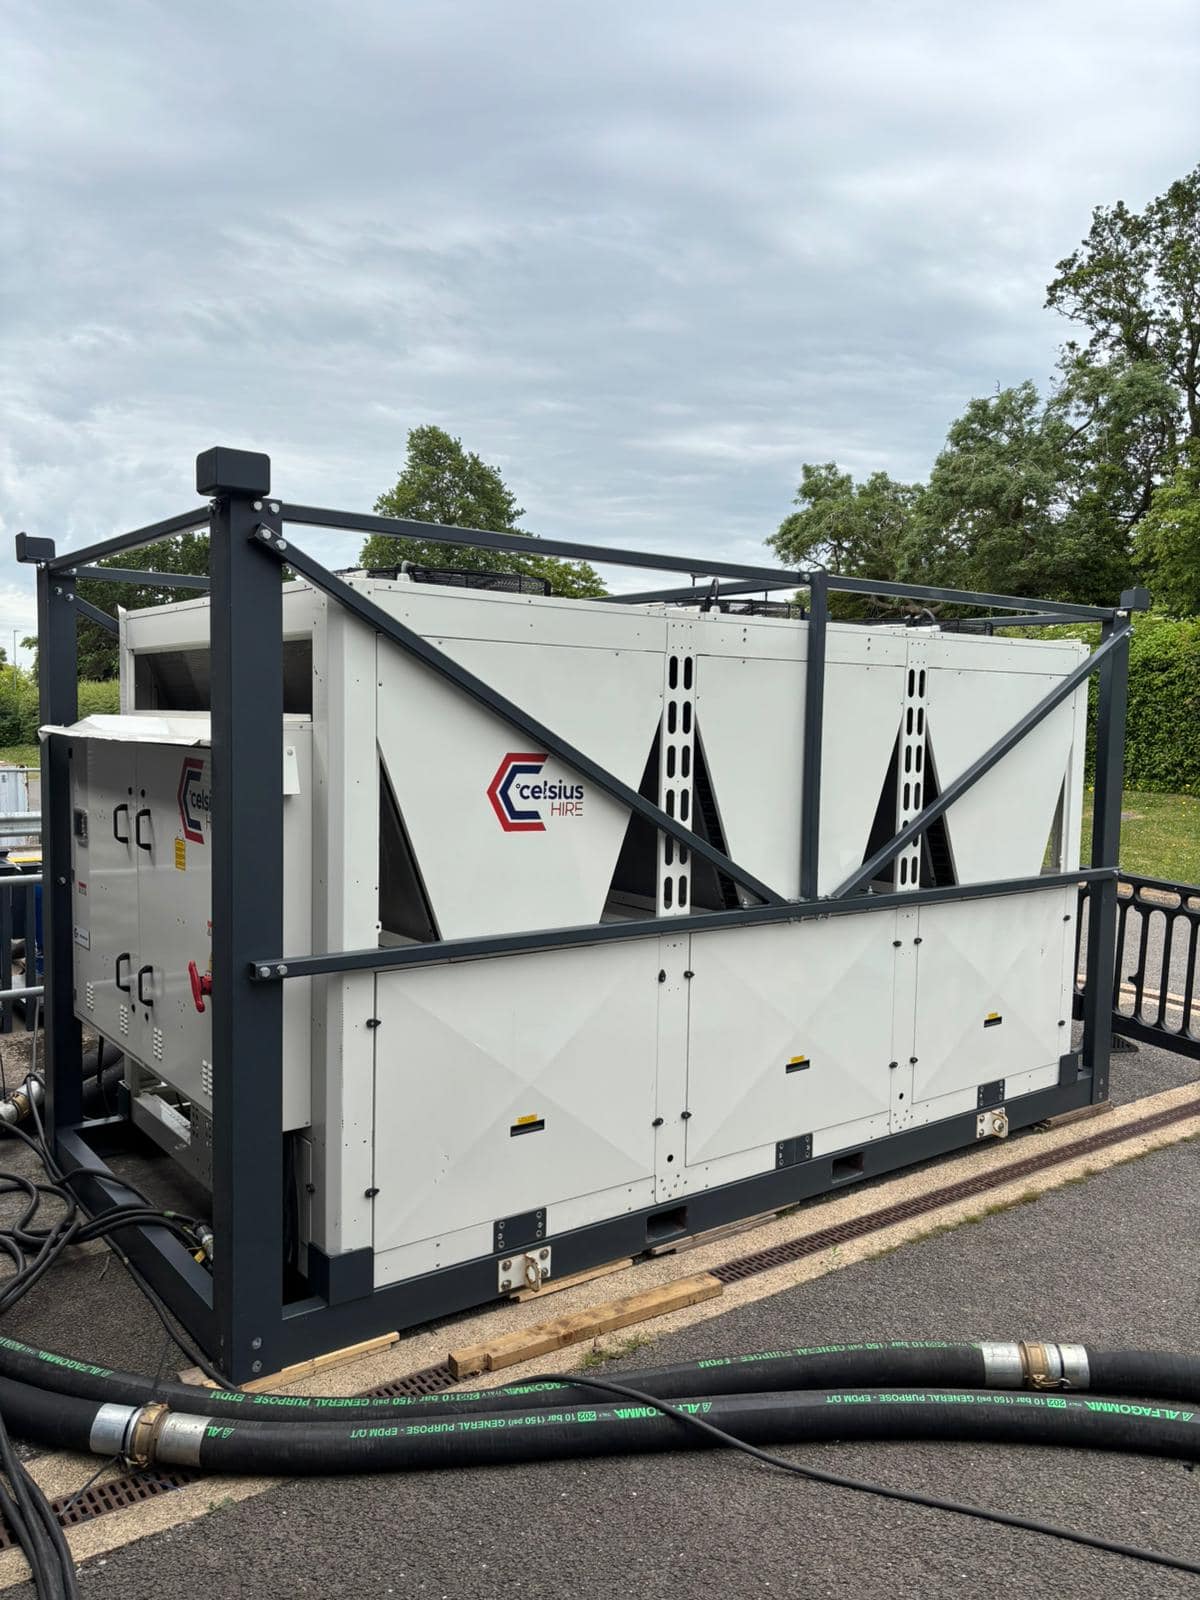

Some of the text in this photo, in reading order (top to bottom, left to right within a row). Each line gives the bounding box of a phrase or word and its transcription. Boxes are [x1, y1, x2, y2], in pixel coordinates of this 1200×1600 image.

[551, 802, 584, 817] HIRE
[209, 1391, 246, 1402] EPDM
[253, 1394, 311, 1408] PURPOSE
[420, 1396, 439, 1404] bar
[844, 1394, 872, 1403] EPDM
[878, 1393, 926, 1403] PURPOSE
[926, 1394, 975, 1404] GENERAL
[993, 1396, 1014, 1405] (150
[1016, 1397, 1032, 1405] bar
[313, 1398, 370, 1408] GENERAL
[1084, 1401, 1180, 1420] ALFAGOMMA
[524, 1415, 546, 1426] (150
[546, 1414, 563, 1423] bar
[564, 1413, 576, 1422] 10
[406, 1423, 456, 1435] PURPOSE
[457, 1419, 506, 1430] GENERAL
[369, 1426, 398, 1437] EPDM
